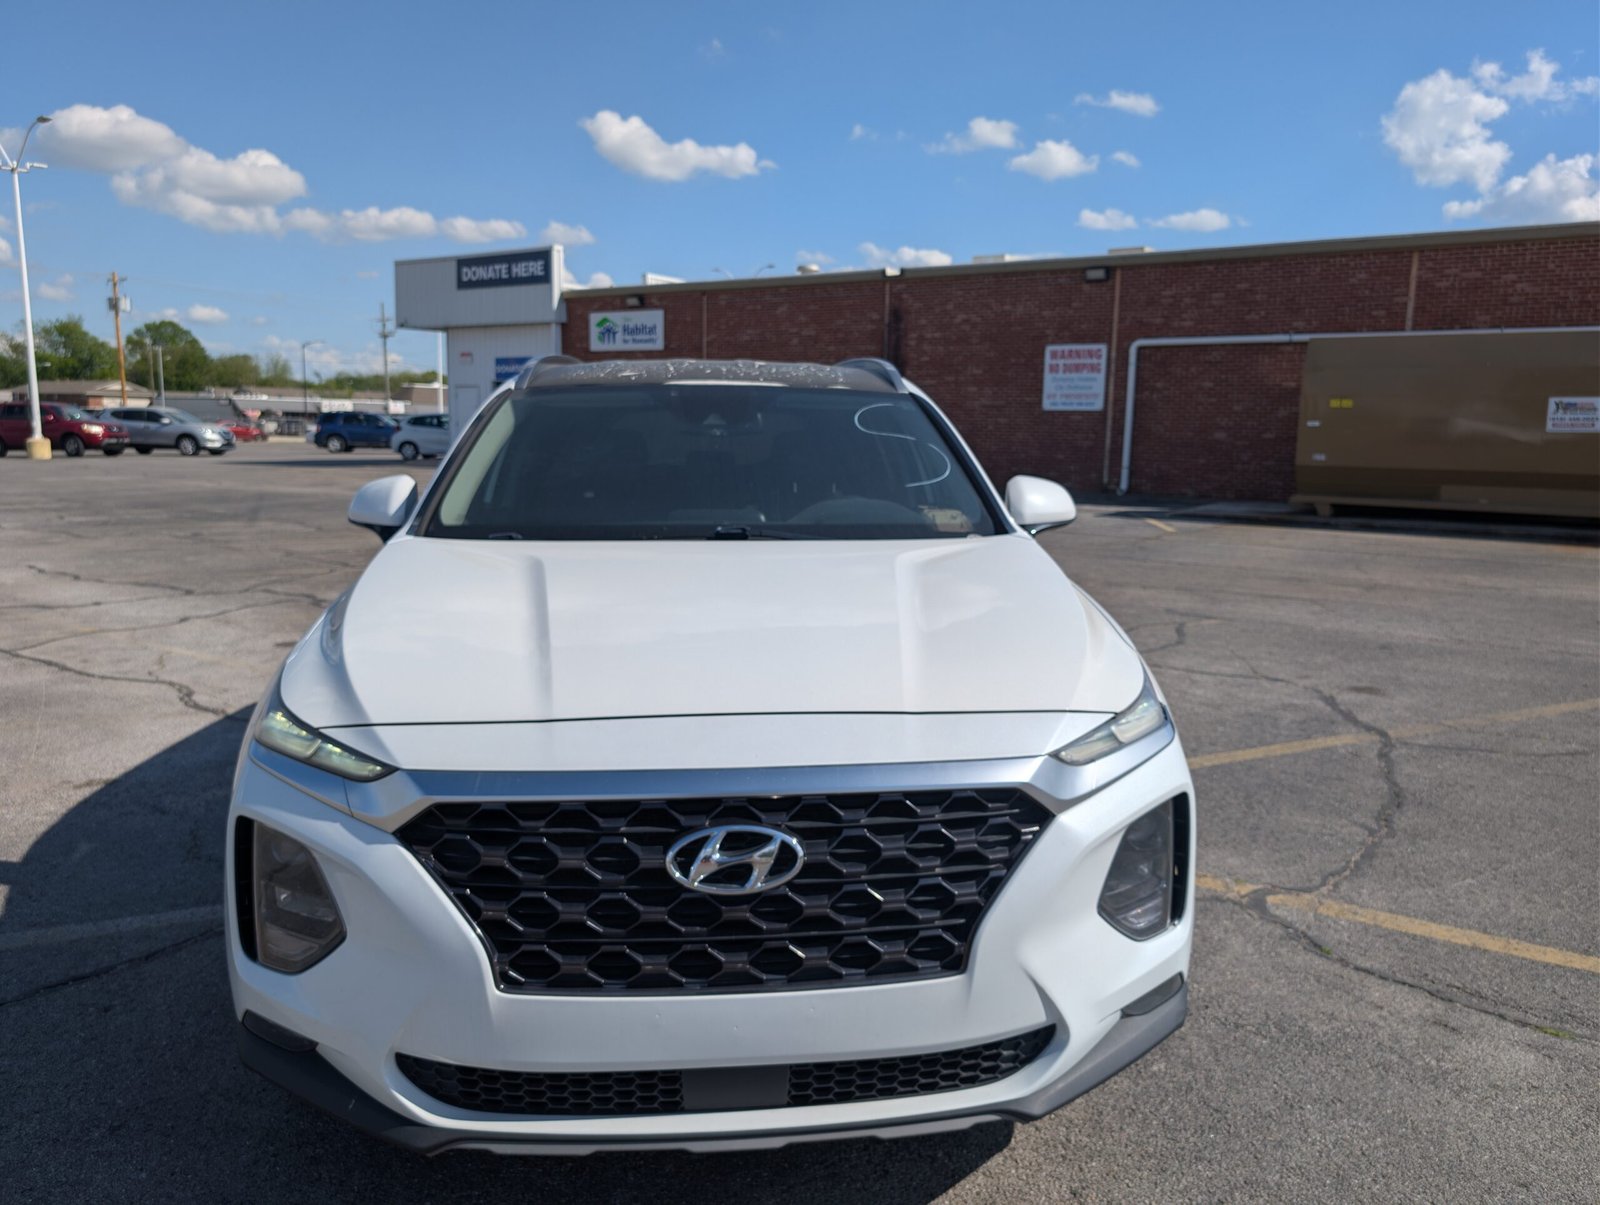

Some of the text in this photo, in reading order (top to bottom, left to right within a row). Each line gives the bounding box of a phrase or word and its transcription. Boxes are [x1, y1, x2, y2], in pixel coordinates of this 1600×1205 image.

[461, 260, 545, 282] DONATE HERE
[622, 323, 658, 336] Habitat
[1049, 349, 1103, 360] WARNING
[1049, 363, 1102, 375] NO DUMPING
